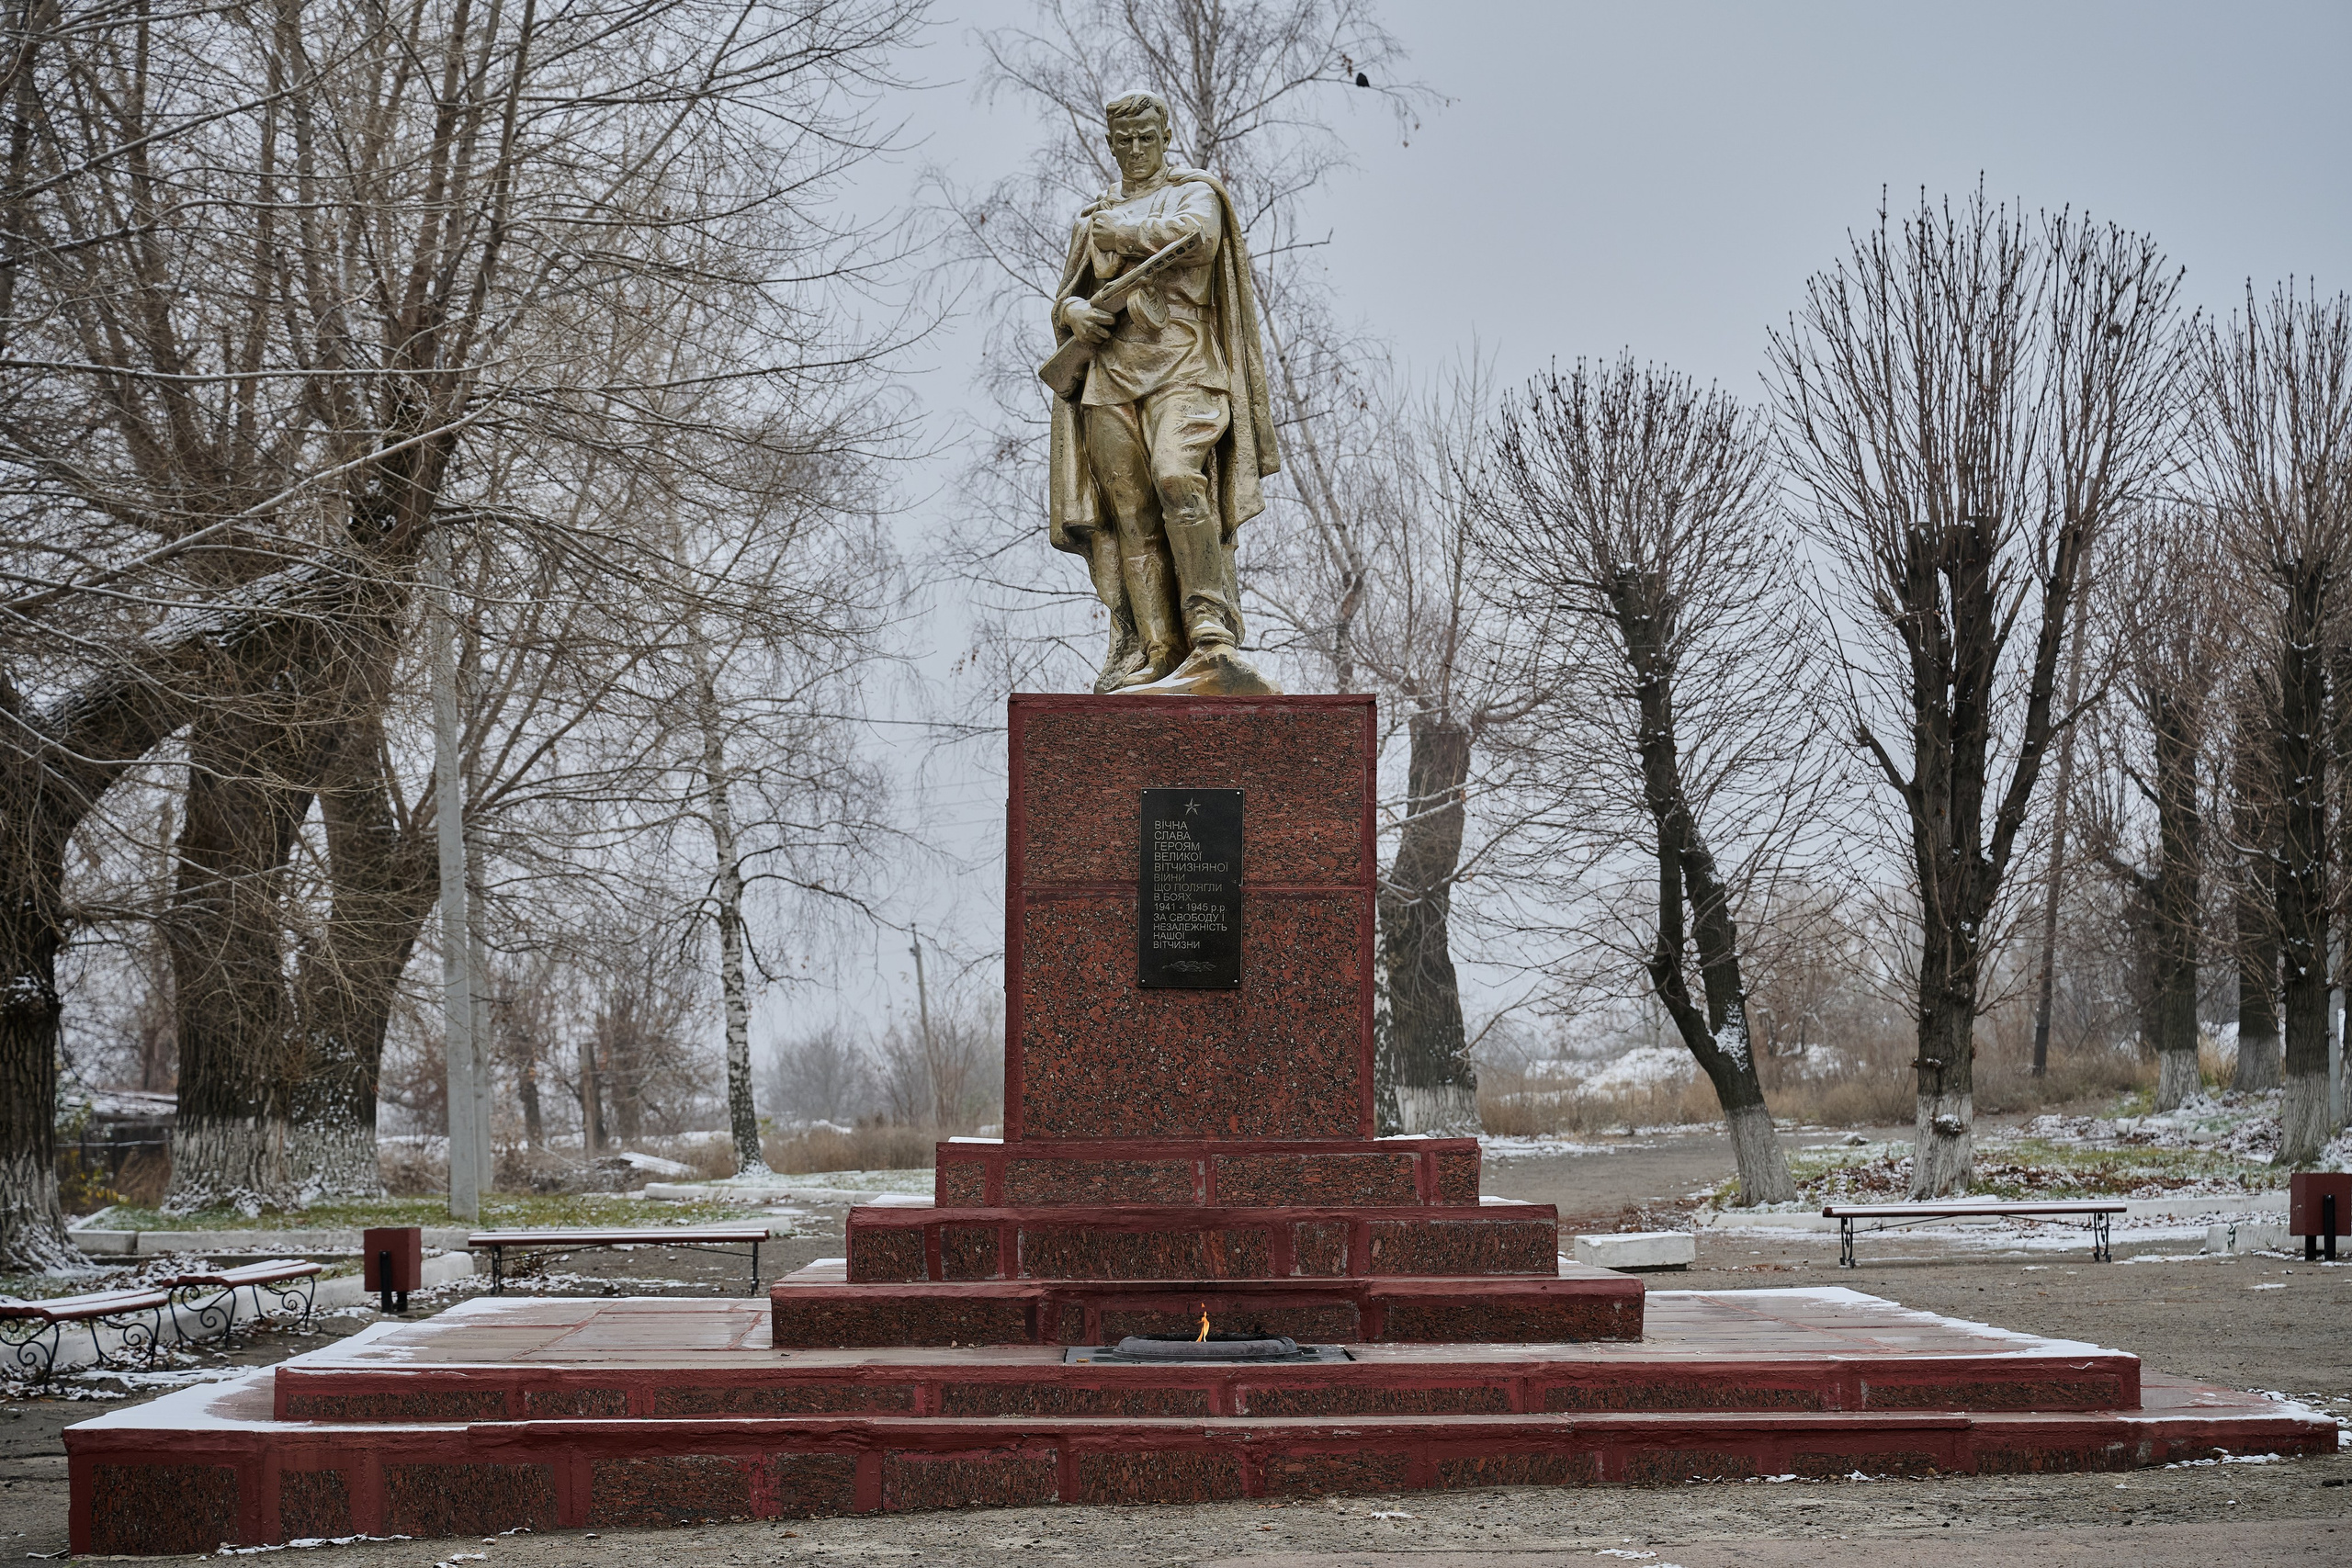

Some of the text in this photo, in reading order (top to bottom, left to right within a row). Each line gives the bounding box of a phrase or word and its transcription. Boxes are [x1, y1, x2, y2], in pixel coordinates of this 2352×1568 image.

[1154, 819, 1188, 830] ВІЧНА
[1154, 830, 1192, 840] СЛАВА
[1154, 841, 1201, 852] ГЕРОЯМ
[1154, 851, 1203, 862] ВЕЛИКОЇ
[1154, 862, 1229, 873] ВІТЧИЗНЯНОЇ
[1153, 872, 1186, 882] ВІЙНИ
[1153, 883, 1223, 893] ЩО ПОЛЯГЛИ
[1153, 893, 1160, 901] В
[1154, 902, 1176, 911] 1941
[1185, 902, 1209, 911] 1945
[1153, 912, 1167, 922] ЗА
[1169, 912, 1219, 923] СВОБОДУ
[1153, 922, 1228, 931] НЕЗАЛЕЖНІСТЬ
[1153, 931, 1185, 941] НАШОЇ
[1153, 939, 1201, 949] ВІТЧИЗНИ
